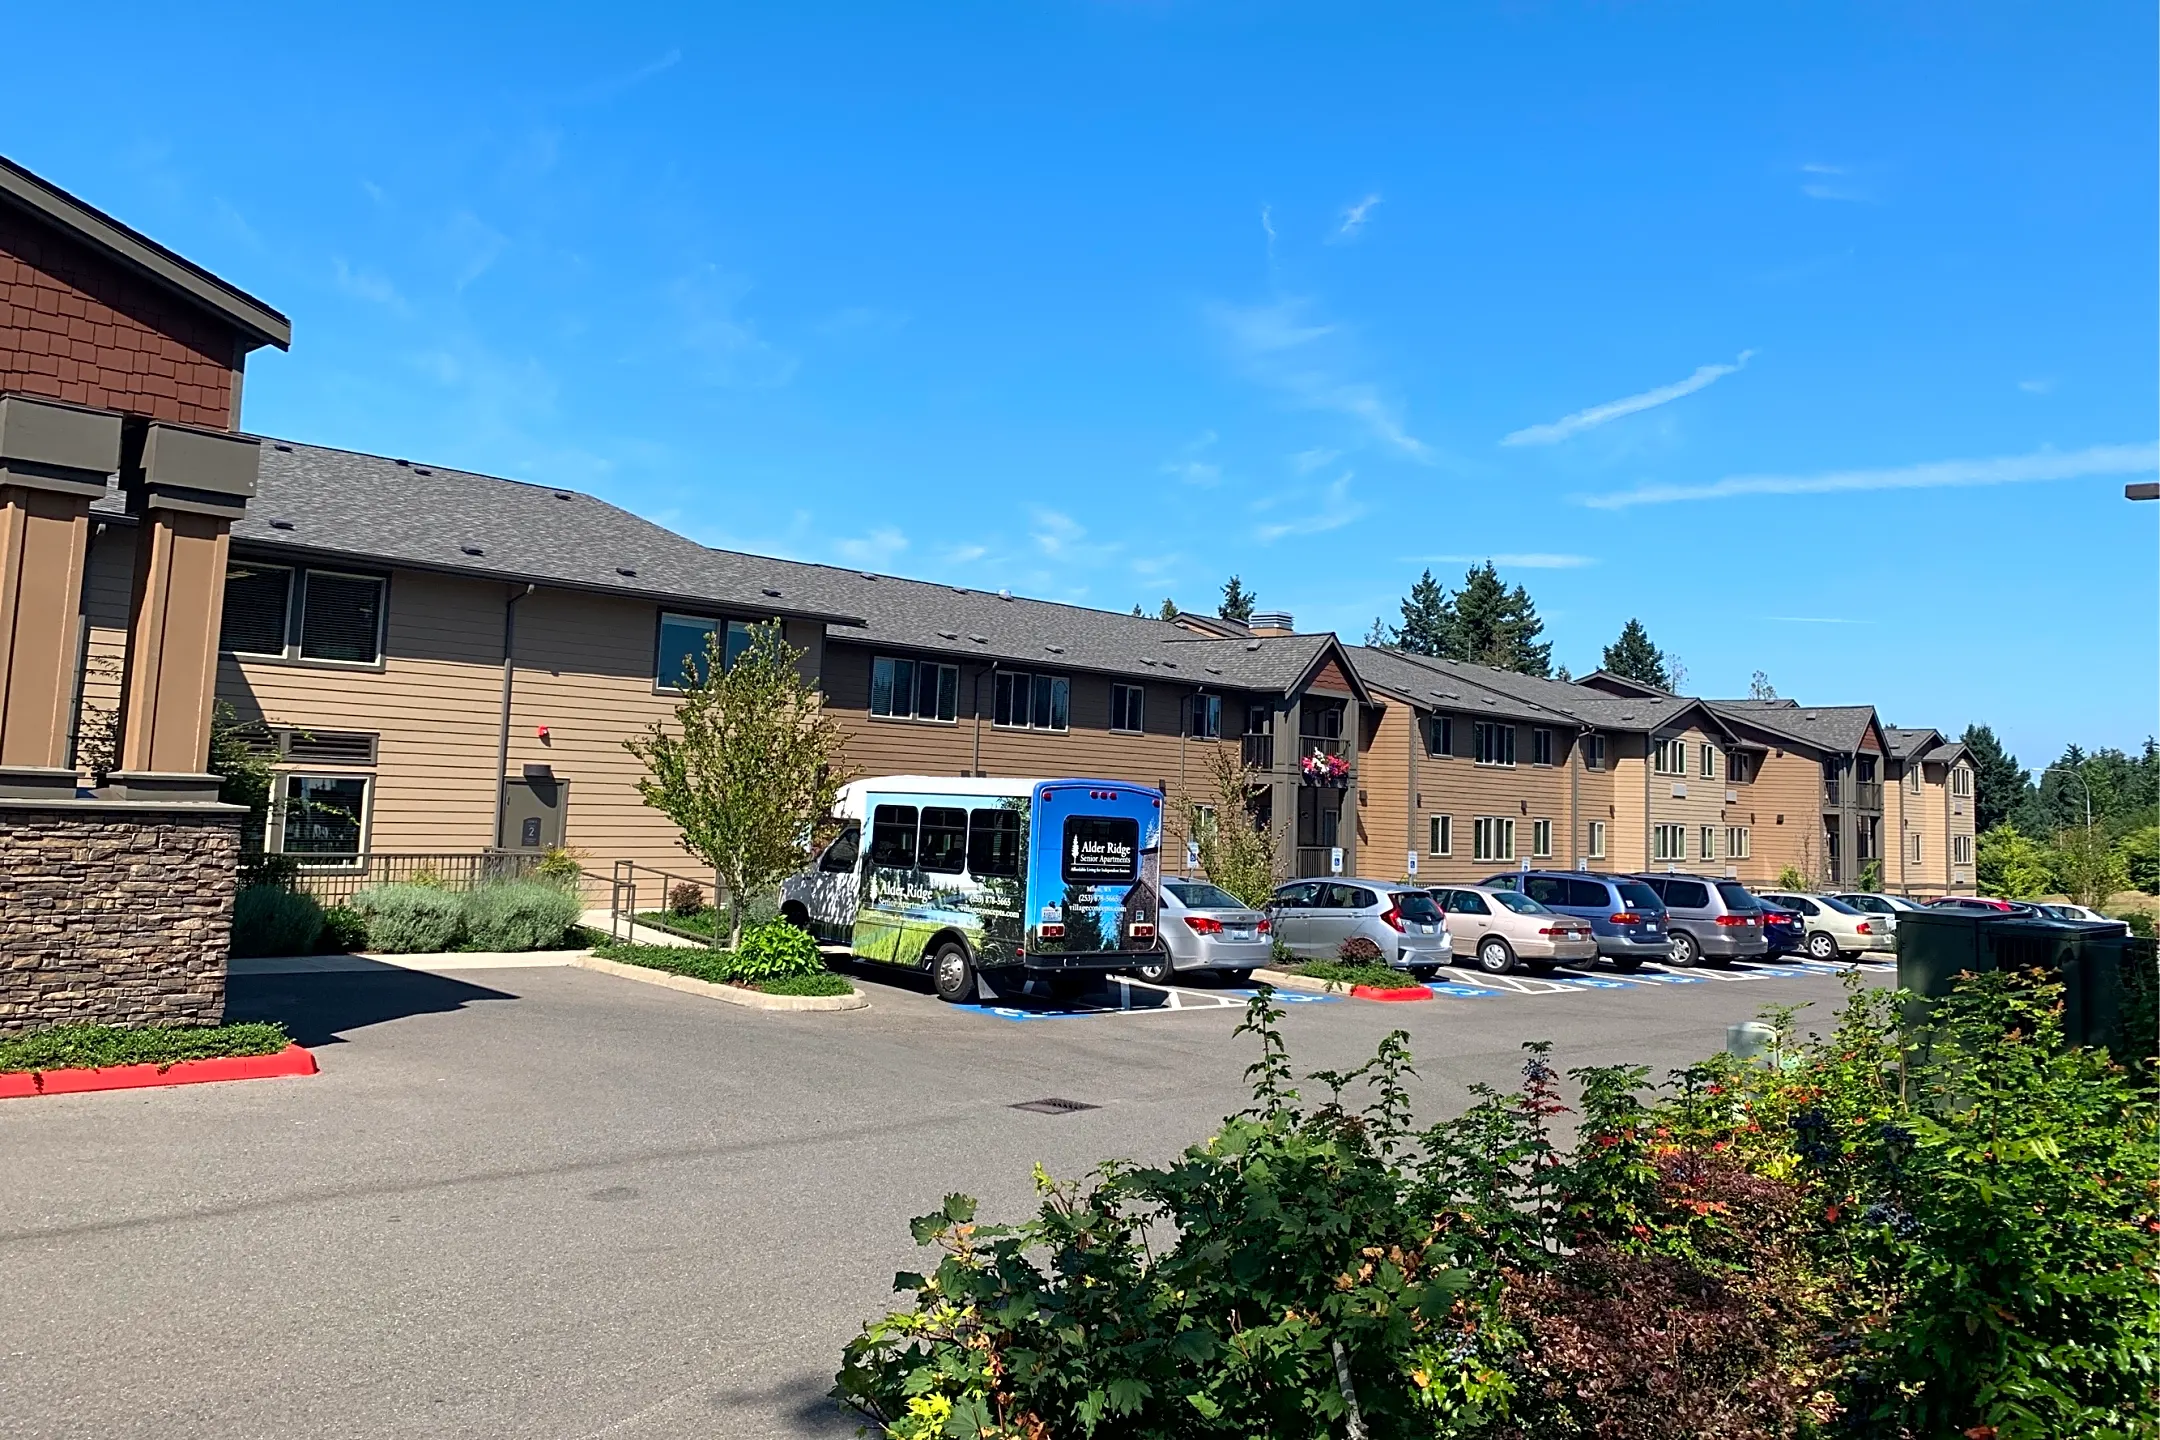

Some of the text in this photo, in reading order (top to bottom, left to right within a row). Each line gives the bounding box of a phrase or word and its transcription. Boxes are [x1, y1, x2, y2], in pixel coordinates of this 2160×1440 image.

[529, 827, 535, 836] 2
[1081, 841, 1131, 857] Alder Ridge
[1080, 854, 1131, 864] Senior Apartments
[880, 880, 933, 903] Alder Ridge
[1079, 894, 1093, 903] (253)
